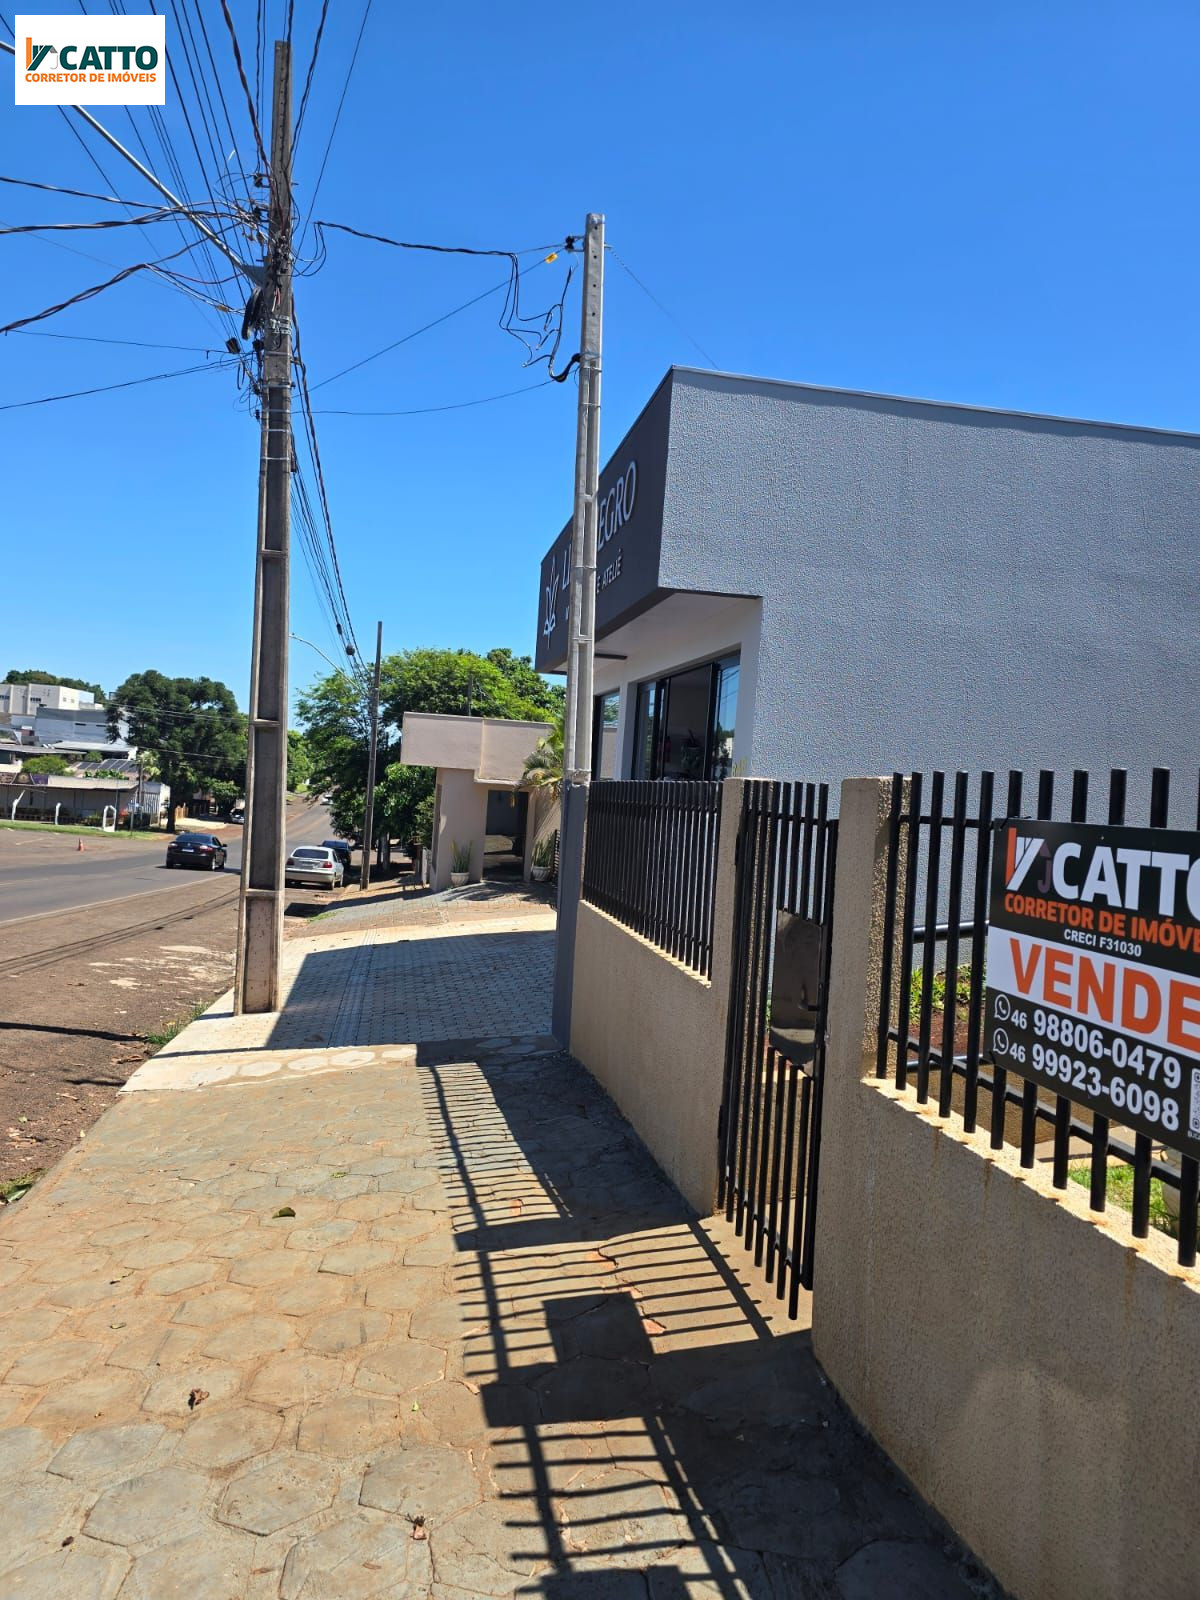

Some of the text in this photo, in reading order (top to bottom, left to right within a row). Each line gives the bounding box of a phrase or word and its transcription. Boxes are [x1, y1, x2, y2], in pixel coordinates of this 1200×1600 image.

[597, 460, 637, 552] EGRO
[1004, 893, 1094, 931] CORRETOR
[1098, 910, 1126, 937] DE
[1064, 929, 1142, 957] CRECI F31030
[1009, 1042, 1179, 1131] 46 99923-6098
[1011, 1009, 1181, 1089] 46 98806-0479
